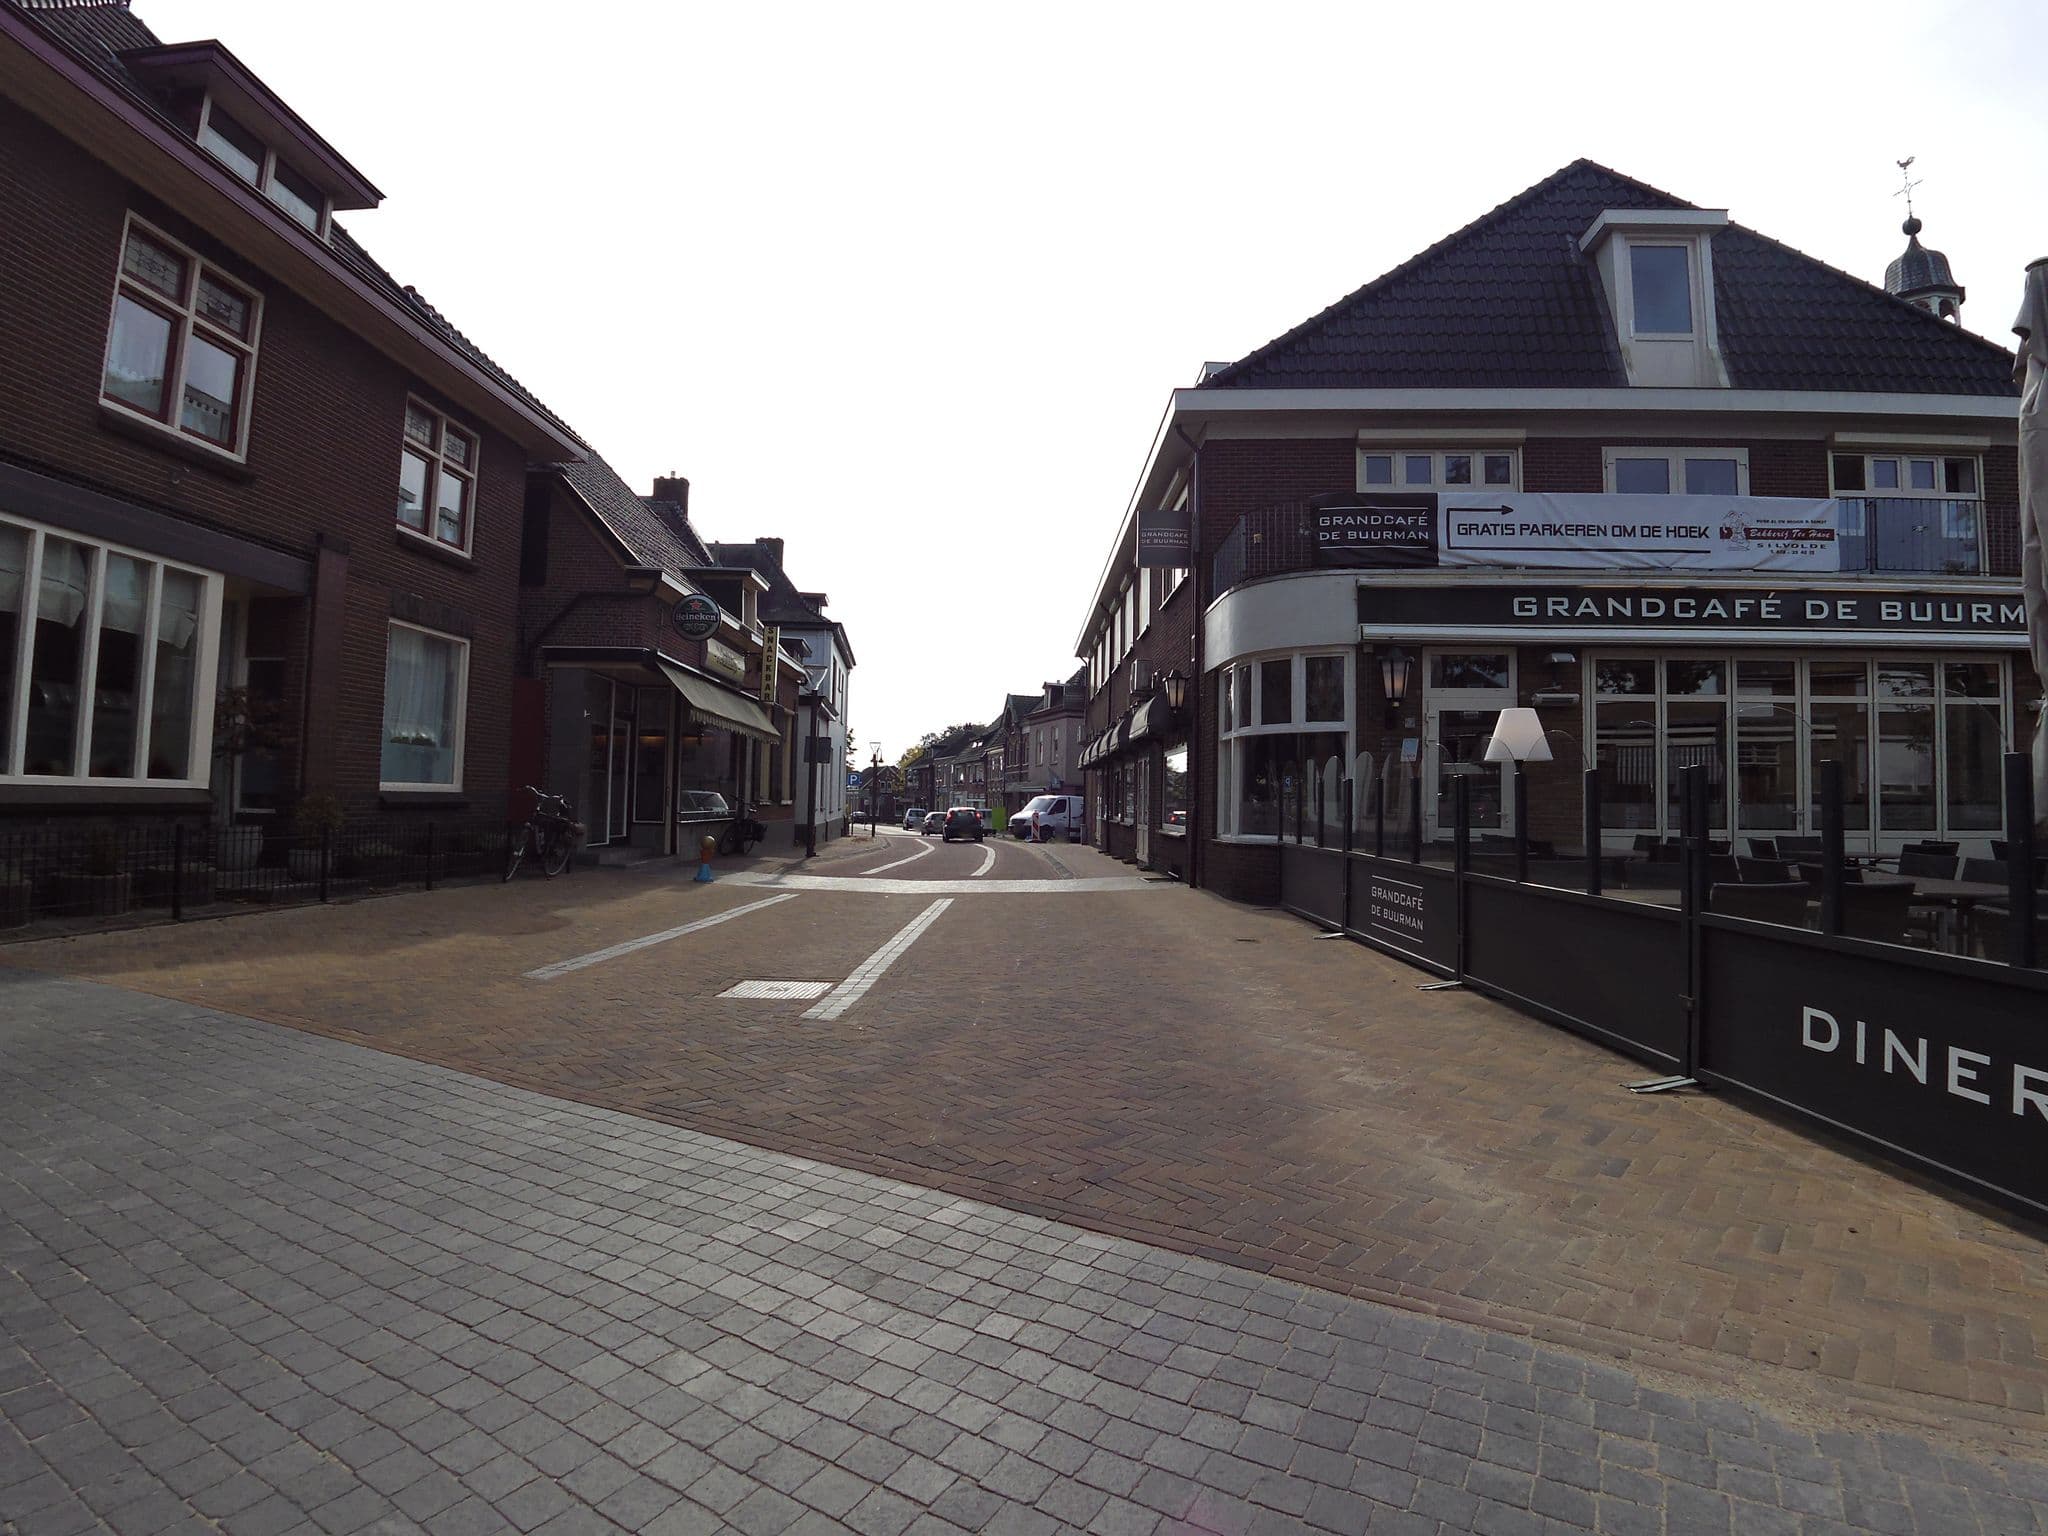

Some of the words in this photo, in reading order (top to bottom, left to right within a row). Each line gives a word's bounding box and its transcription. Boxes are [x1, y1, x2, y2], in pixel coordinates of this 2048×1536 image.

[1319, 511, 1428, 526] GRANDCAFÉ
[1319, 531, 1341, 541] DE
[1347, 531, 1429, 541] BUURMAN
[1457, 523, 1516, 536] GRATIS
[1519, 523, 1608, 537] PARKEREN
[1611, 524, 1636, 538] OM
[1640, 525, 1662, 538] DE
[1666, 526, 1710, 539] HOEK
[1757, 542, 1828, 550] SILVOLDE
[675, 611, 717, 621] Heineken
[1512, 592, 1782, 620] GRANDCAFÉ
[1805, 600, 1858, 621] DE
[763, 627, 775, 701] SNACKBAR
[1371, 886, 1423, 910] GRANDCAFÉ
[1371, 904, 1381, 916] DE
[1383, 908, 1423, 930] BUURMAN
[1802, 1005, 2048, 1123] DINER
